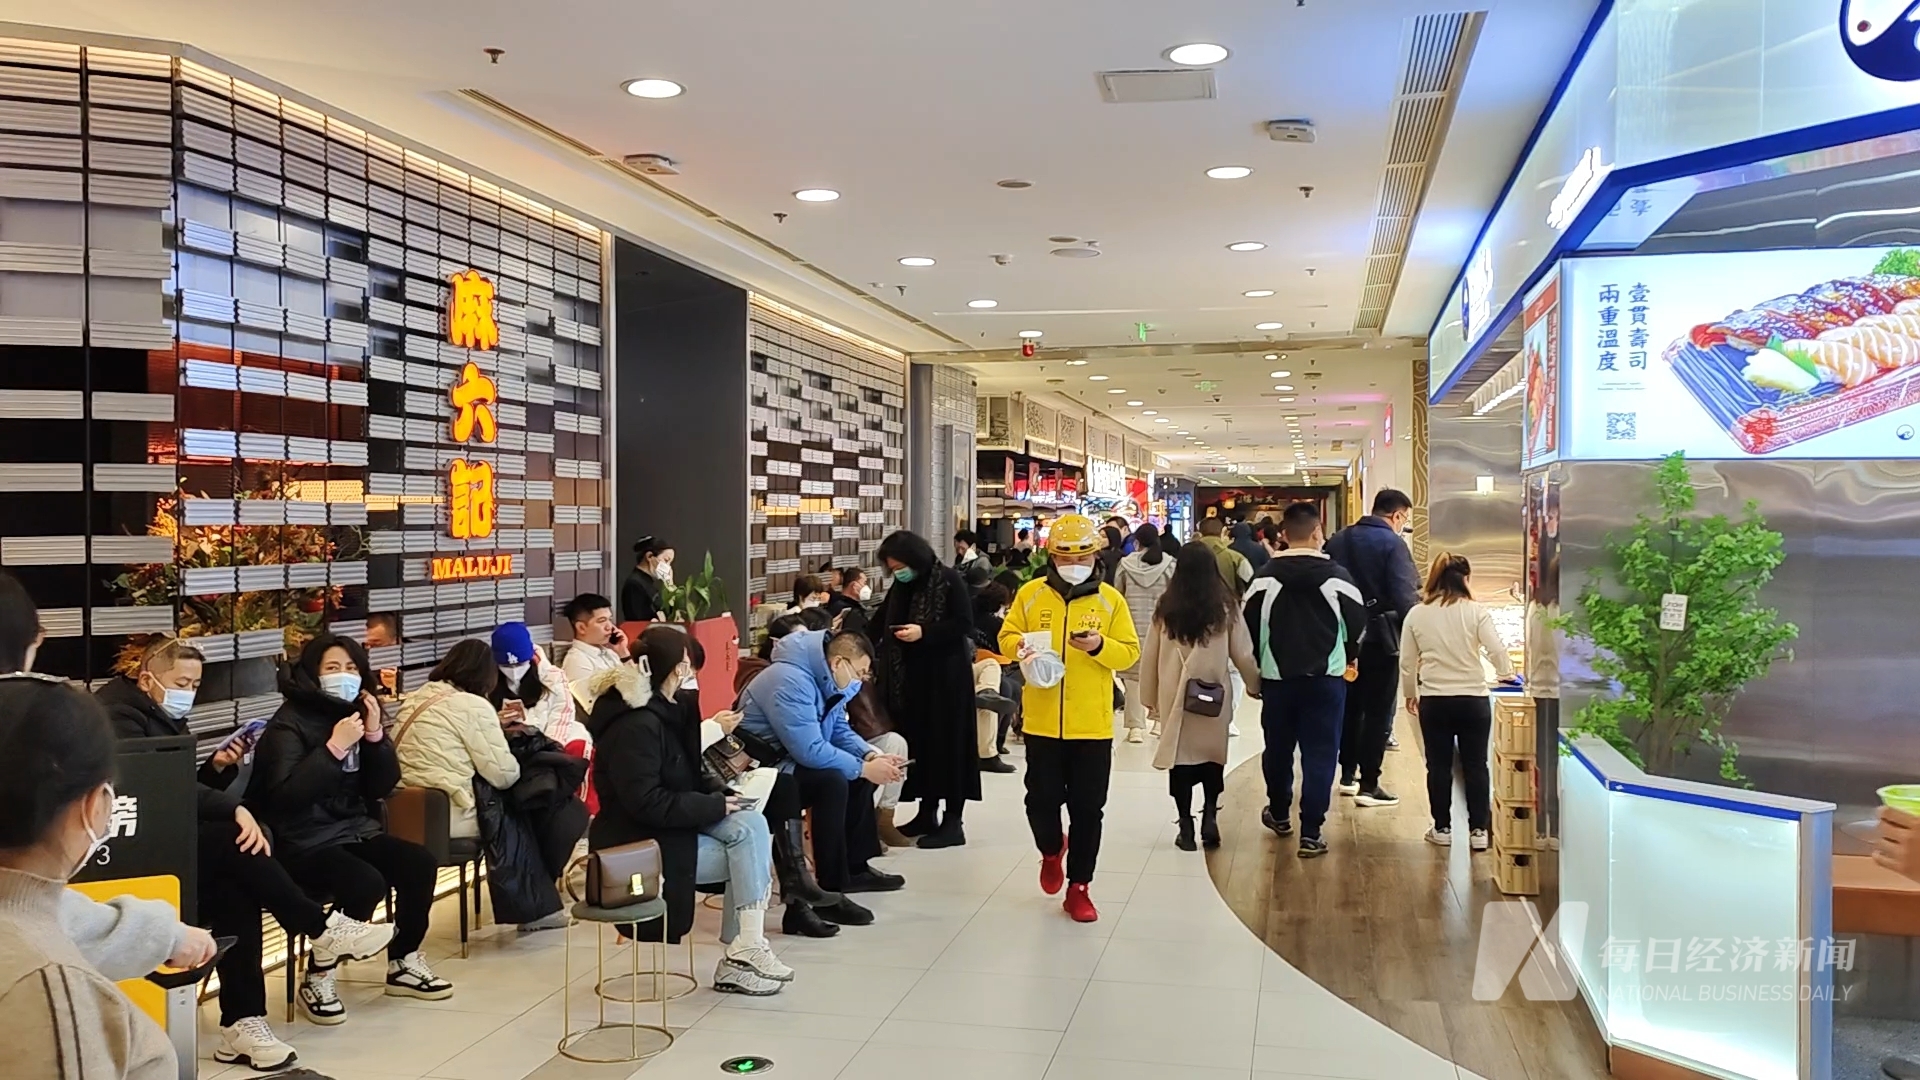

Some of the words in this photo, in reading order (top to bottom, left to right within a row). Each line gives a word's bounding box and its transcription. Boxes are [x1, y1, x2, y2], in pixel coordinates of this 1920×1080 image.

[1596, 283, 1620, 371] 兩重溫度
[1628, 282, 1650, 370] 壹貫壽司
[449, 270, 498, 539] 麻六記
[431, 554, 512, 579] MALUJI
